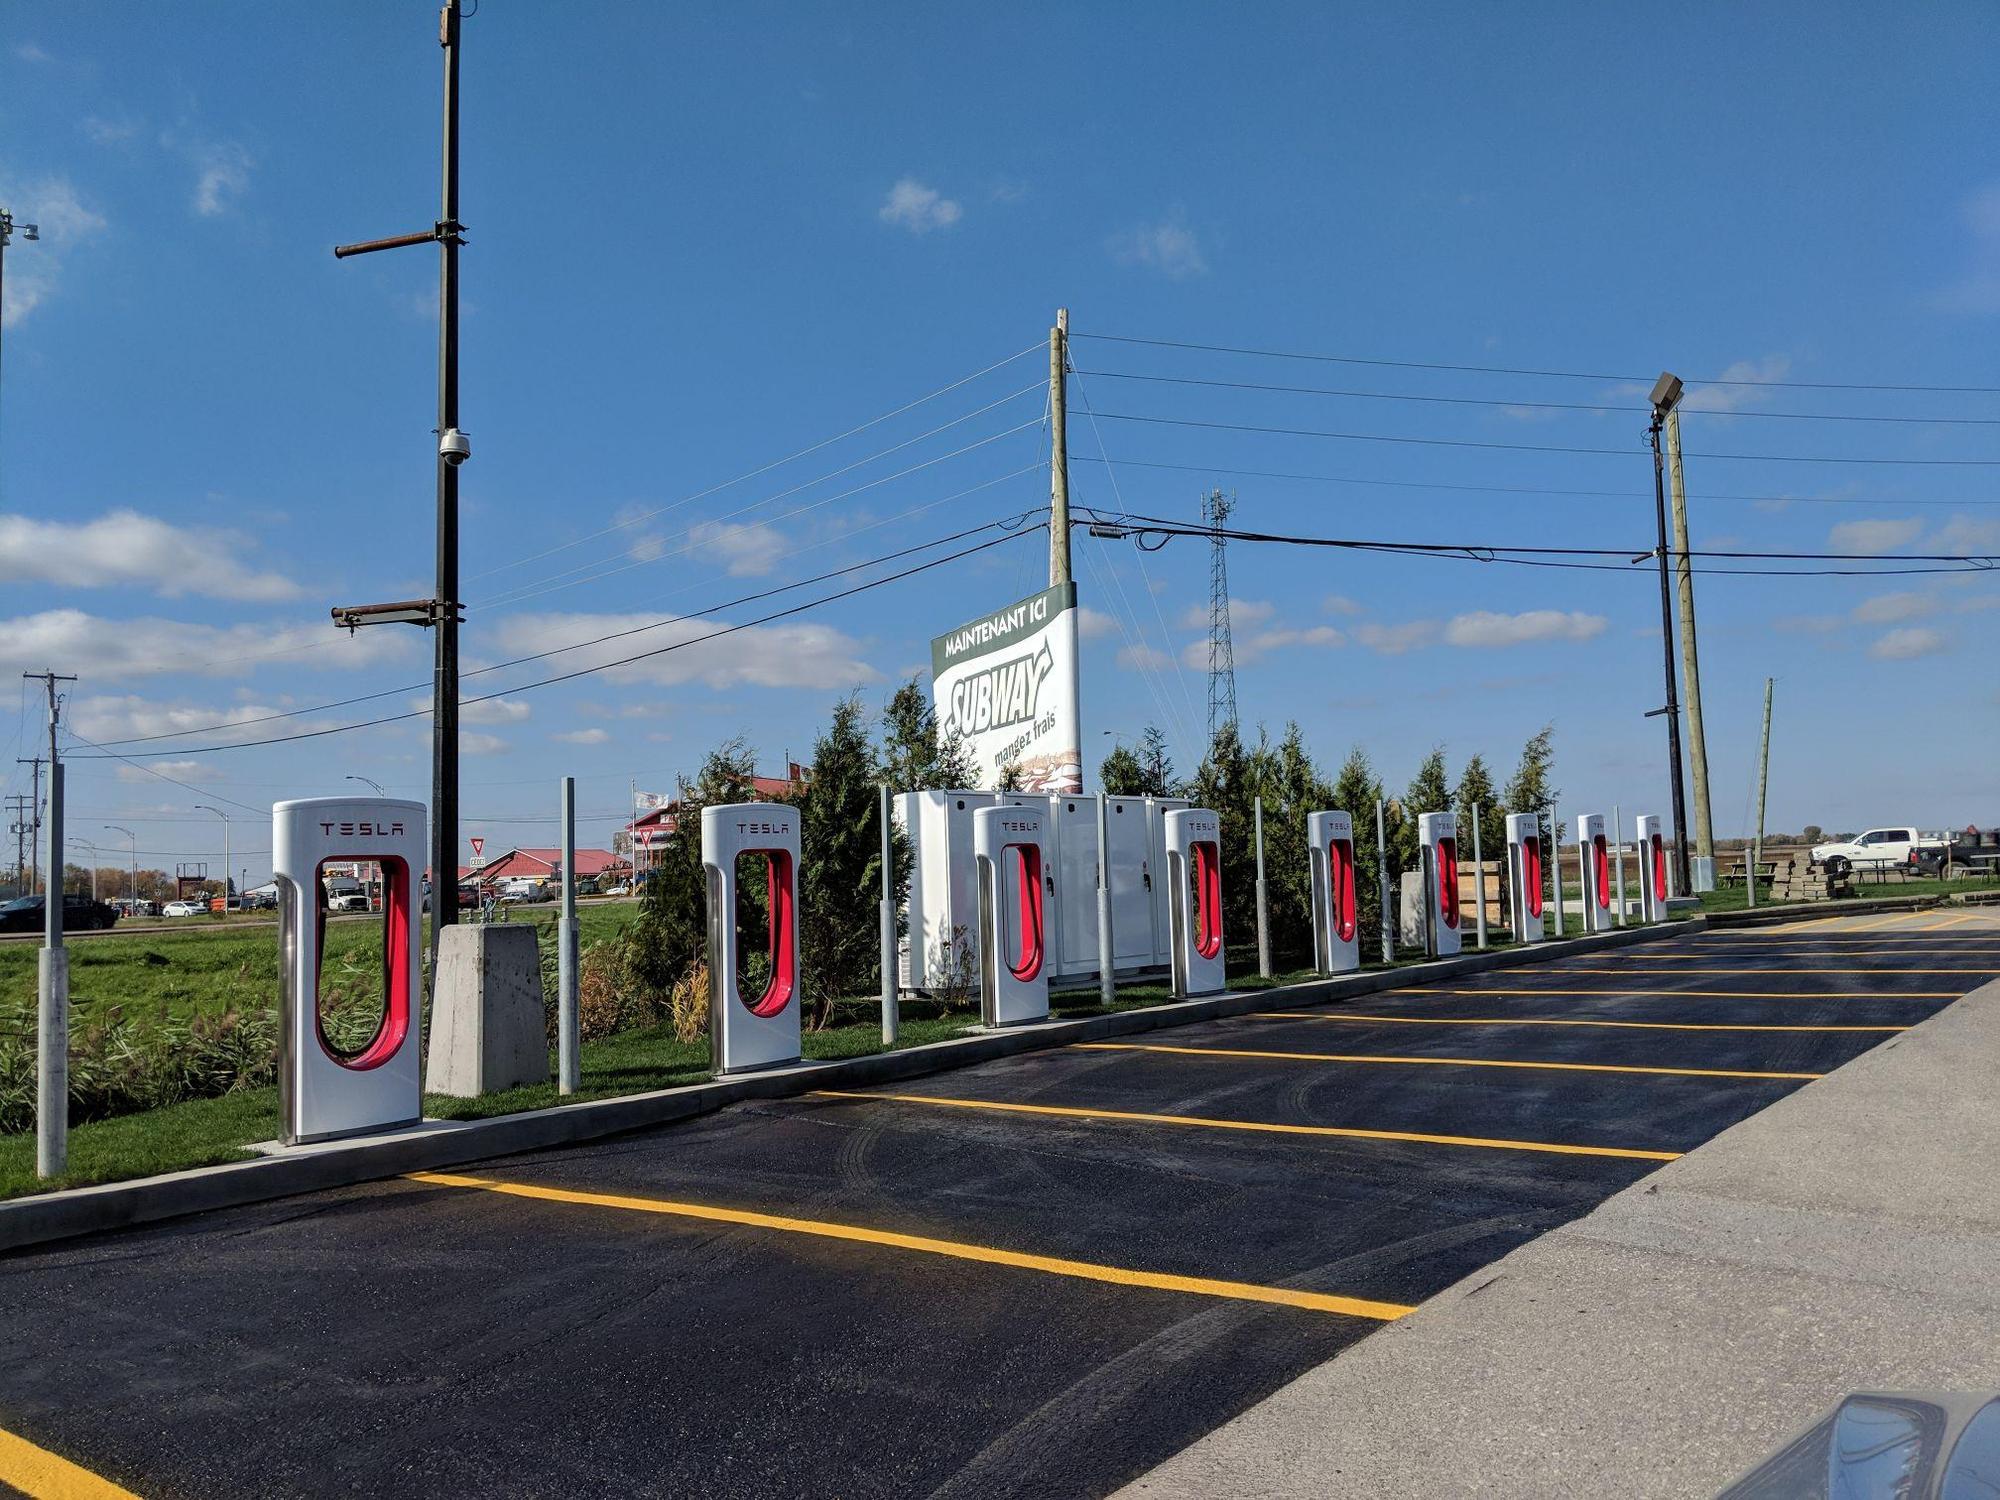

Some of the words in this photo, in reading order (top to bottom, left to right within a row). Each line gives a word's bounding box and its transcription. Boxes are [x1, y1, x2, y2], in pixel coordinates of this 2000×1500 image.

[945, 605, 1027, 659] MAINTENANT
[1030, 596, 1047, 623] ICI
[945, 634, 1054, 741] SUBWAY
[994, 730, 1032, 767] mangez
[1033, 711, 1056, 740] frais
[319, 822, 404, 836] TESLA
[736, 823, 789, 834] TESLA
[1002, 822, 1039, 832] TESLA
[1188, 822, 1216, 831] TESLA
